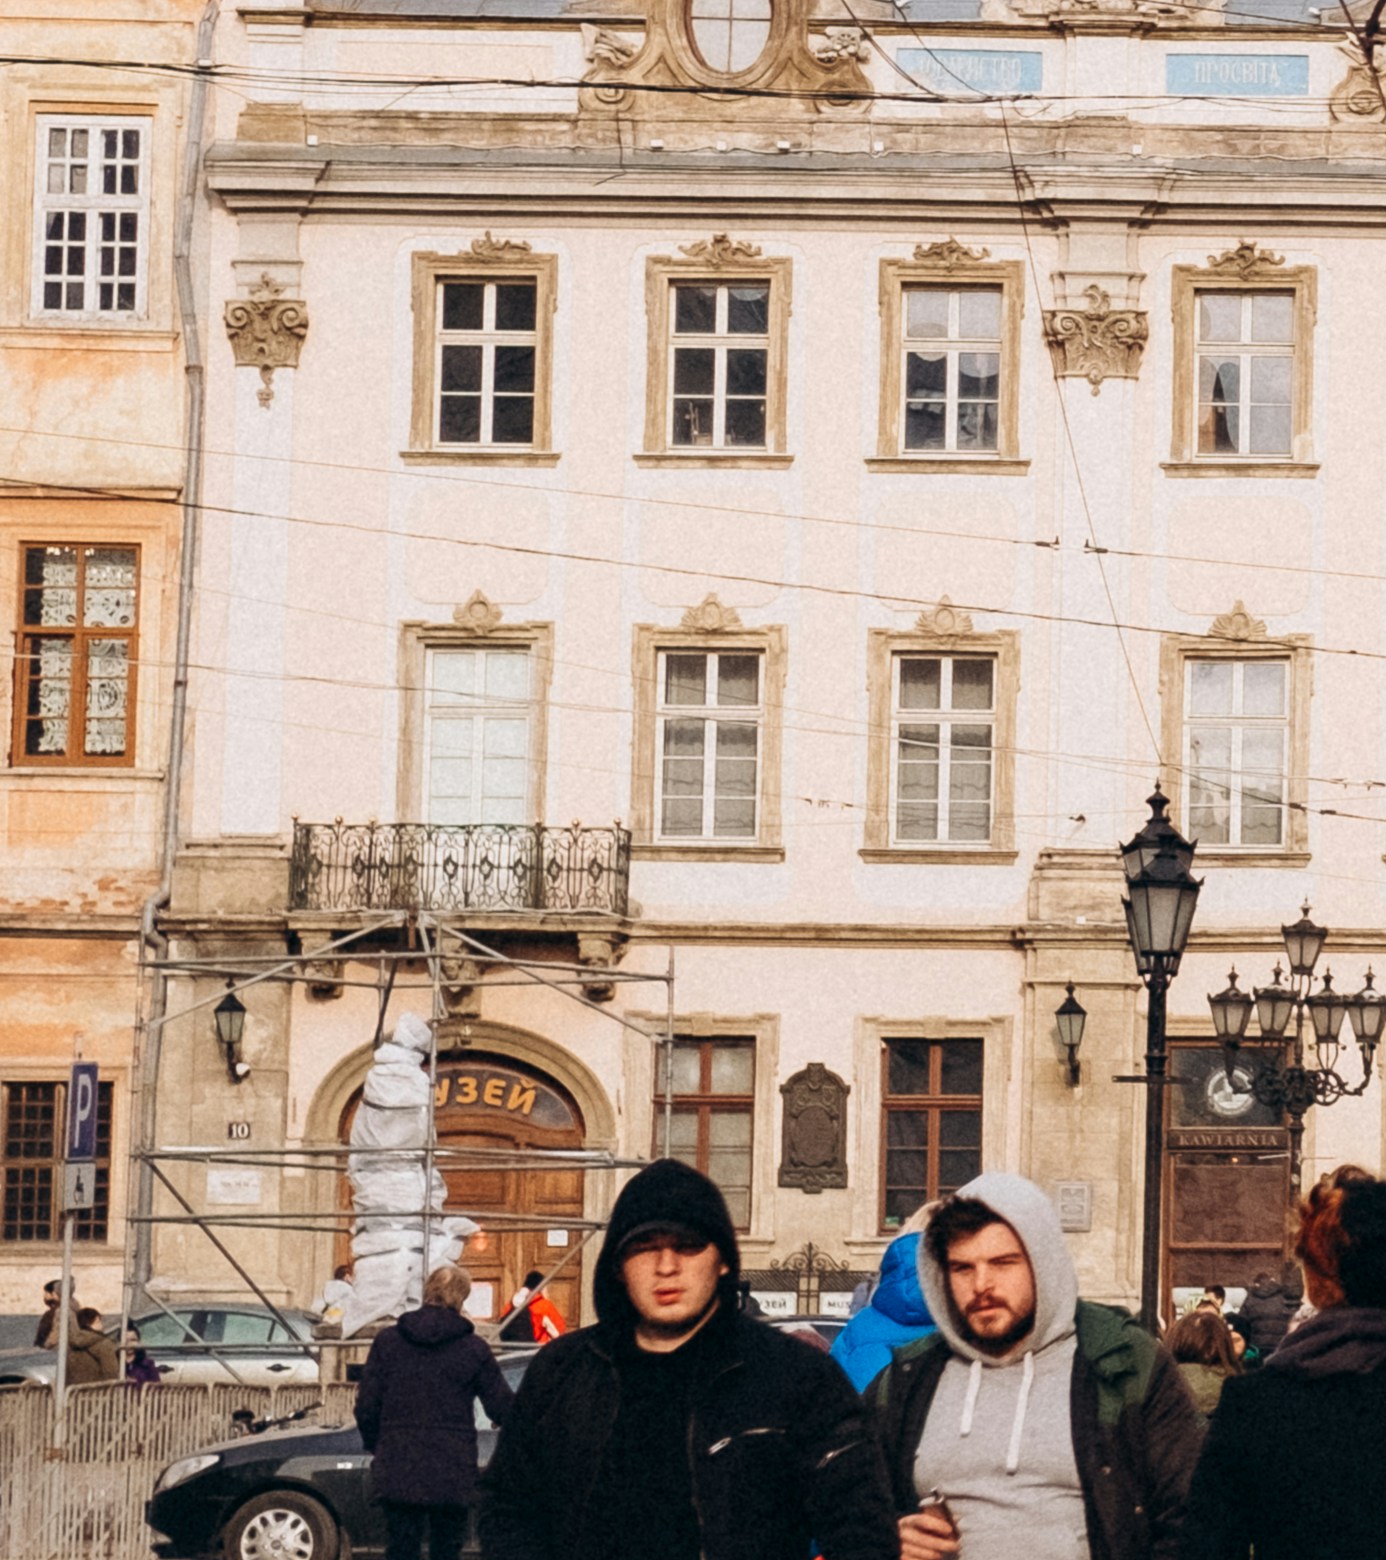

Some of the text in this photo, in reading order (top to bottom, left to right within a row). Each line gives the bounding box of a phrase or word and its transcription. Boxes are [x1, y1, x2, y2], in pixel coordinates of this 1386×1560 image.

[434, 1076, 537, 1116] УЗЕЙ
[74, 1074, 92, 1149] P
[231, 1123, 249, 1138] 10
[1179, 1134, 1278, 1146] KAWIARNIA
[762, 1298, 787, 1309] ЗЕЙ
